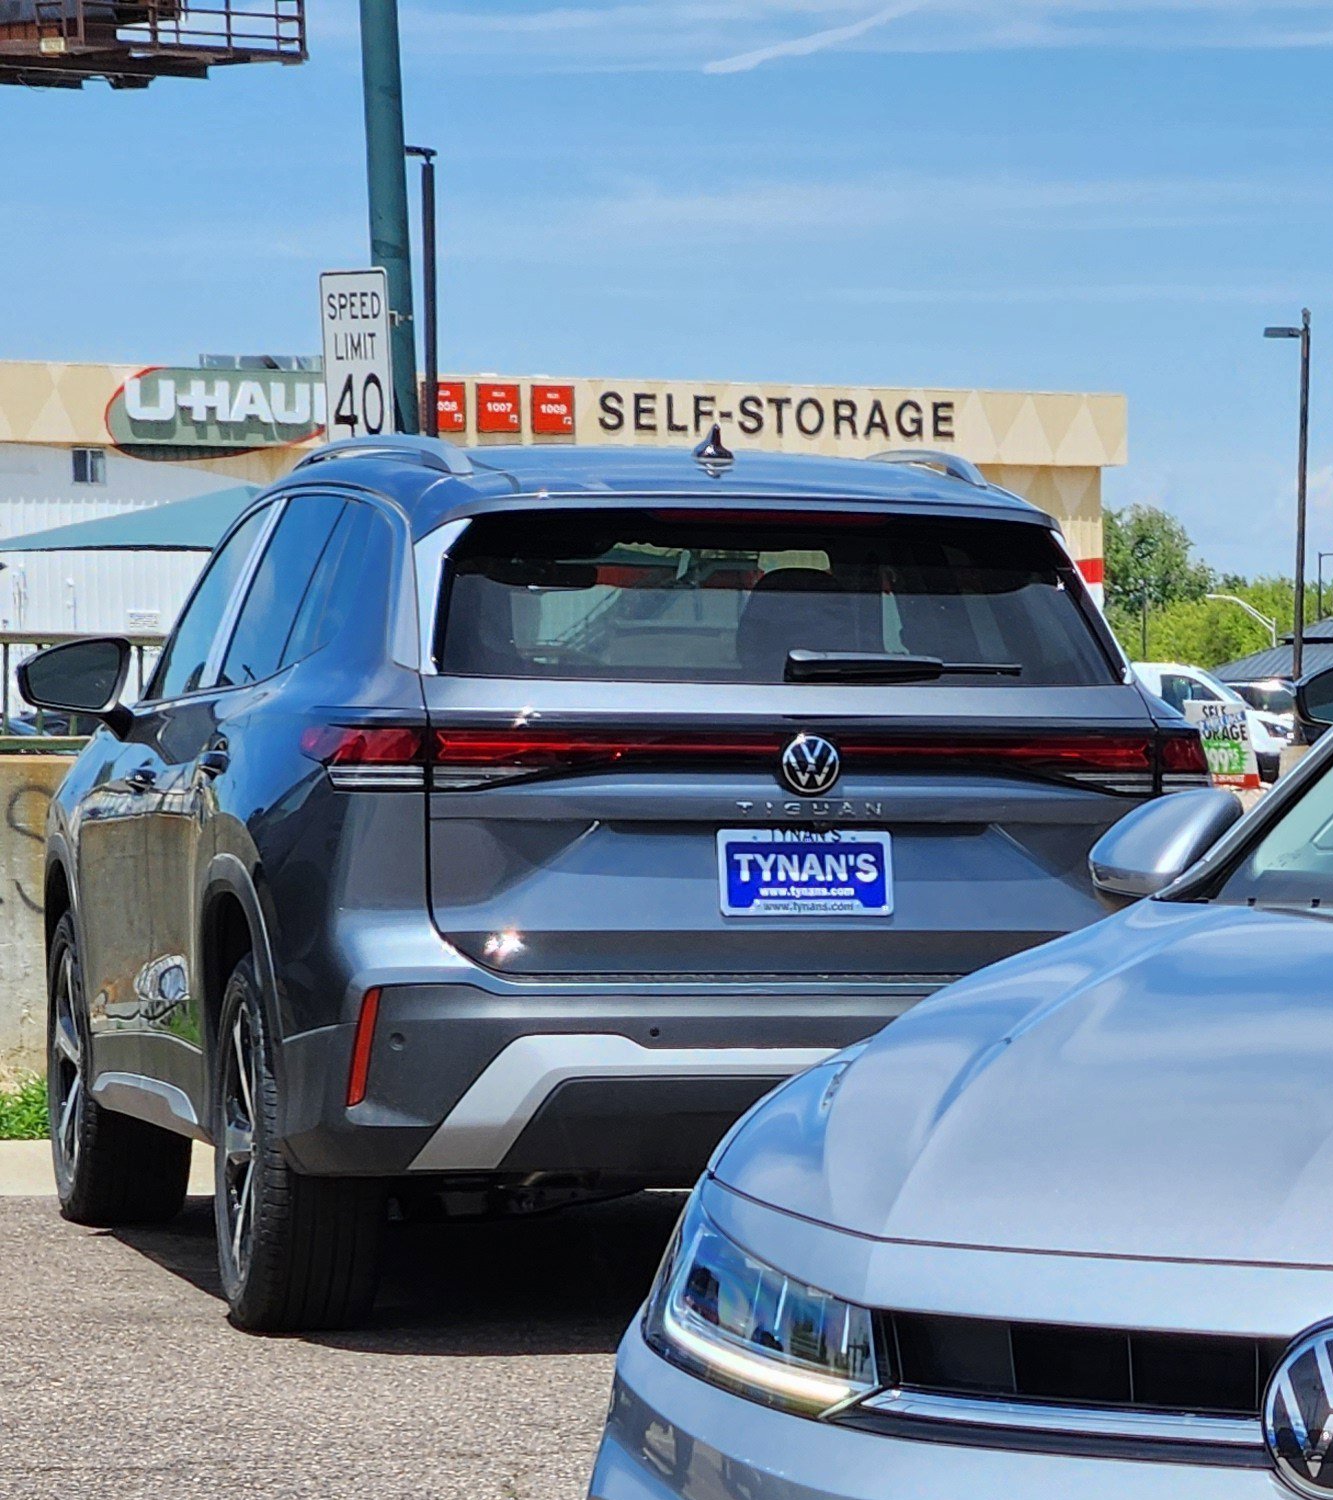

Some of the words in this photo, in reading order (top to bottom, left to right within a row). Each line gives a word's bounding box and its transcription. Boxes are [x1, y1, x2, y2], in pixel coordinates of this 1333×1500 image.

[327, 291, 381, 320] SPEED
[334, 332, 376, 361] LIMIT
[334, 372, 384, 437] 40
[598, 391, 955, 438] SELF-STORAGE
[735, 801, 882, 816] TIGUAN
[733, 853, 878, 883] TYNAN'S
[759, 885, 855, 899] www.tynans.com
[763, 901, 855, 914] www.tynans.com
